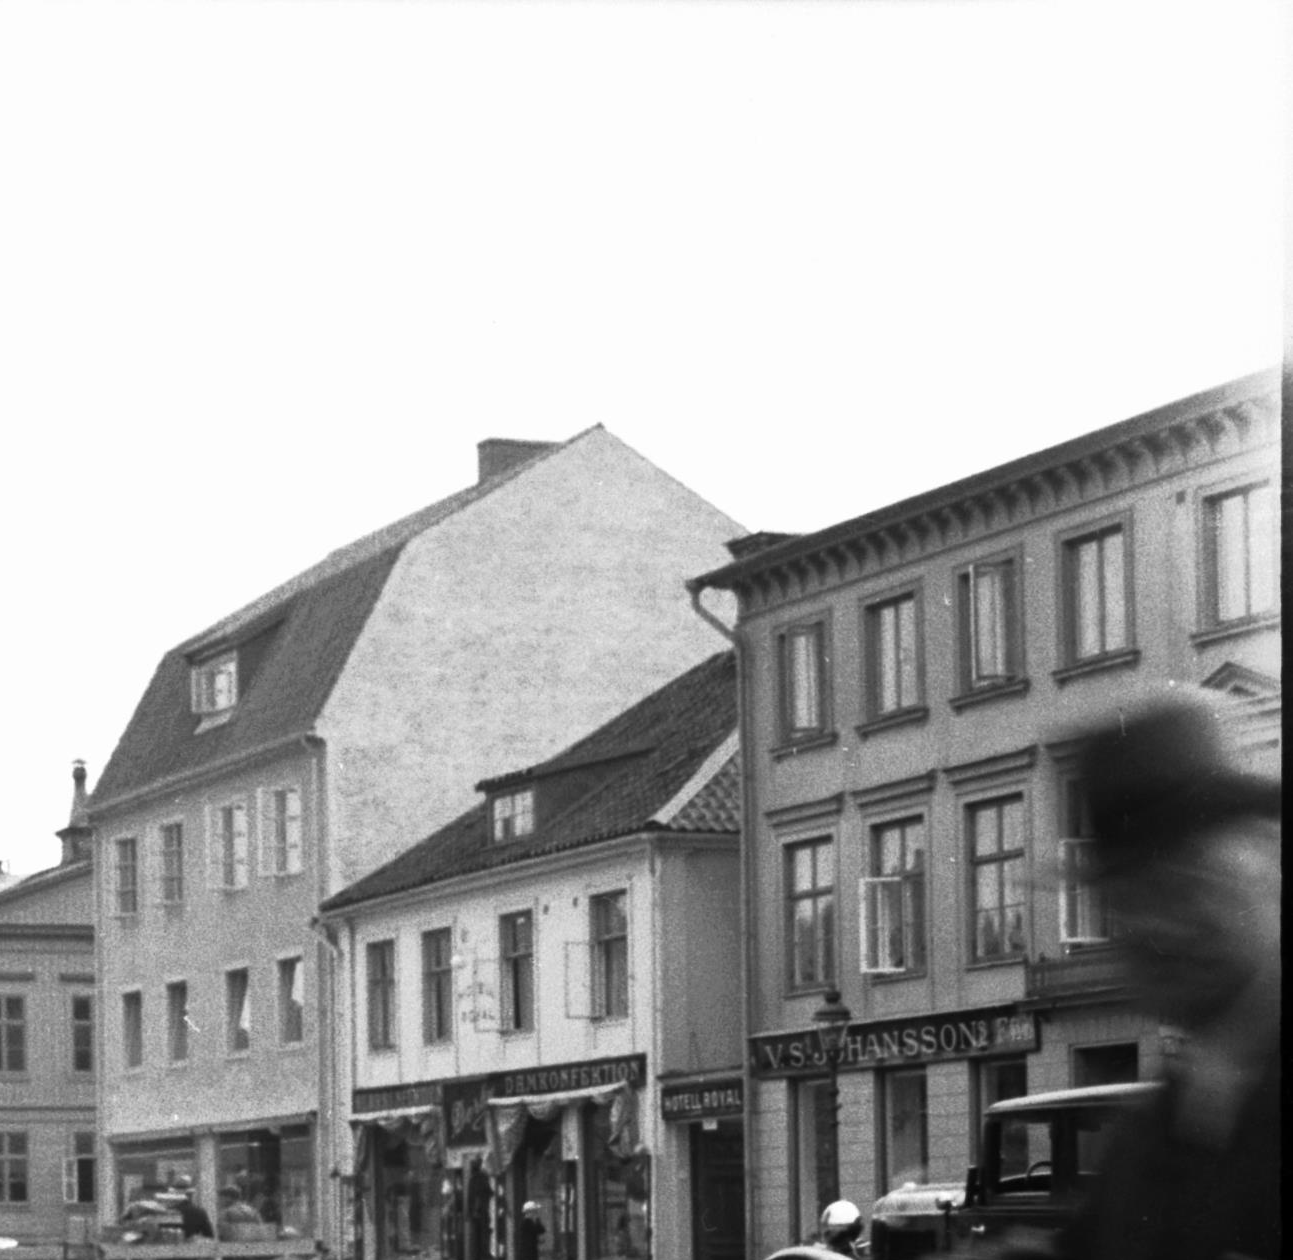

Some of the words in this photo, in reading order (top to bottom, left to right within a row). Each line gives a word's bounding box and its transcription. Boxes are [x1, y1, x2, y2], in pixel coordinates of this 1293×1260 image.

[813, 1020, 988, 1066] JHANSSONS
[504, 1060, 640, 1094] DAMKONFEKTION
[663, 1092, 702, 1112] HOTELL
[703, 1088, 742, 1108] ROYAL
